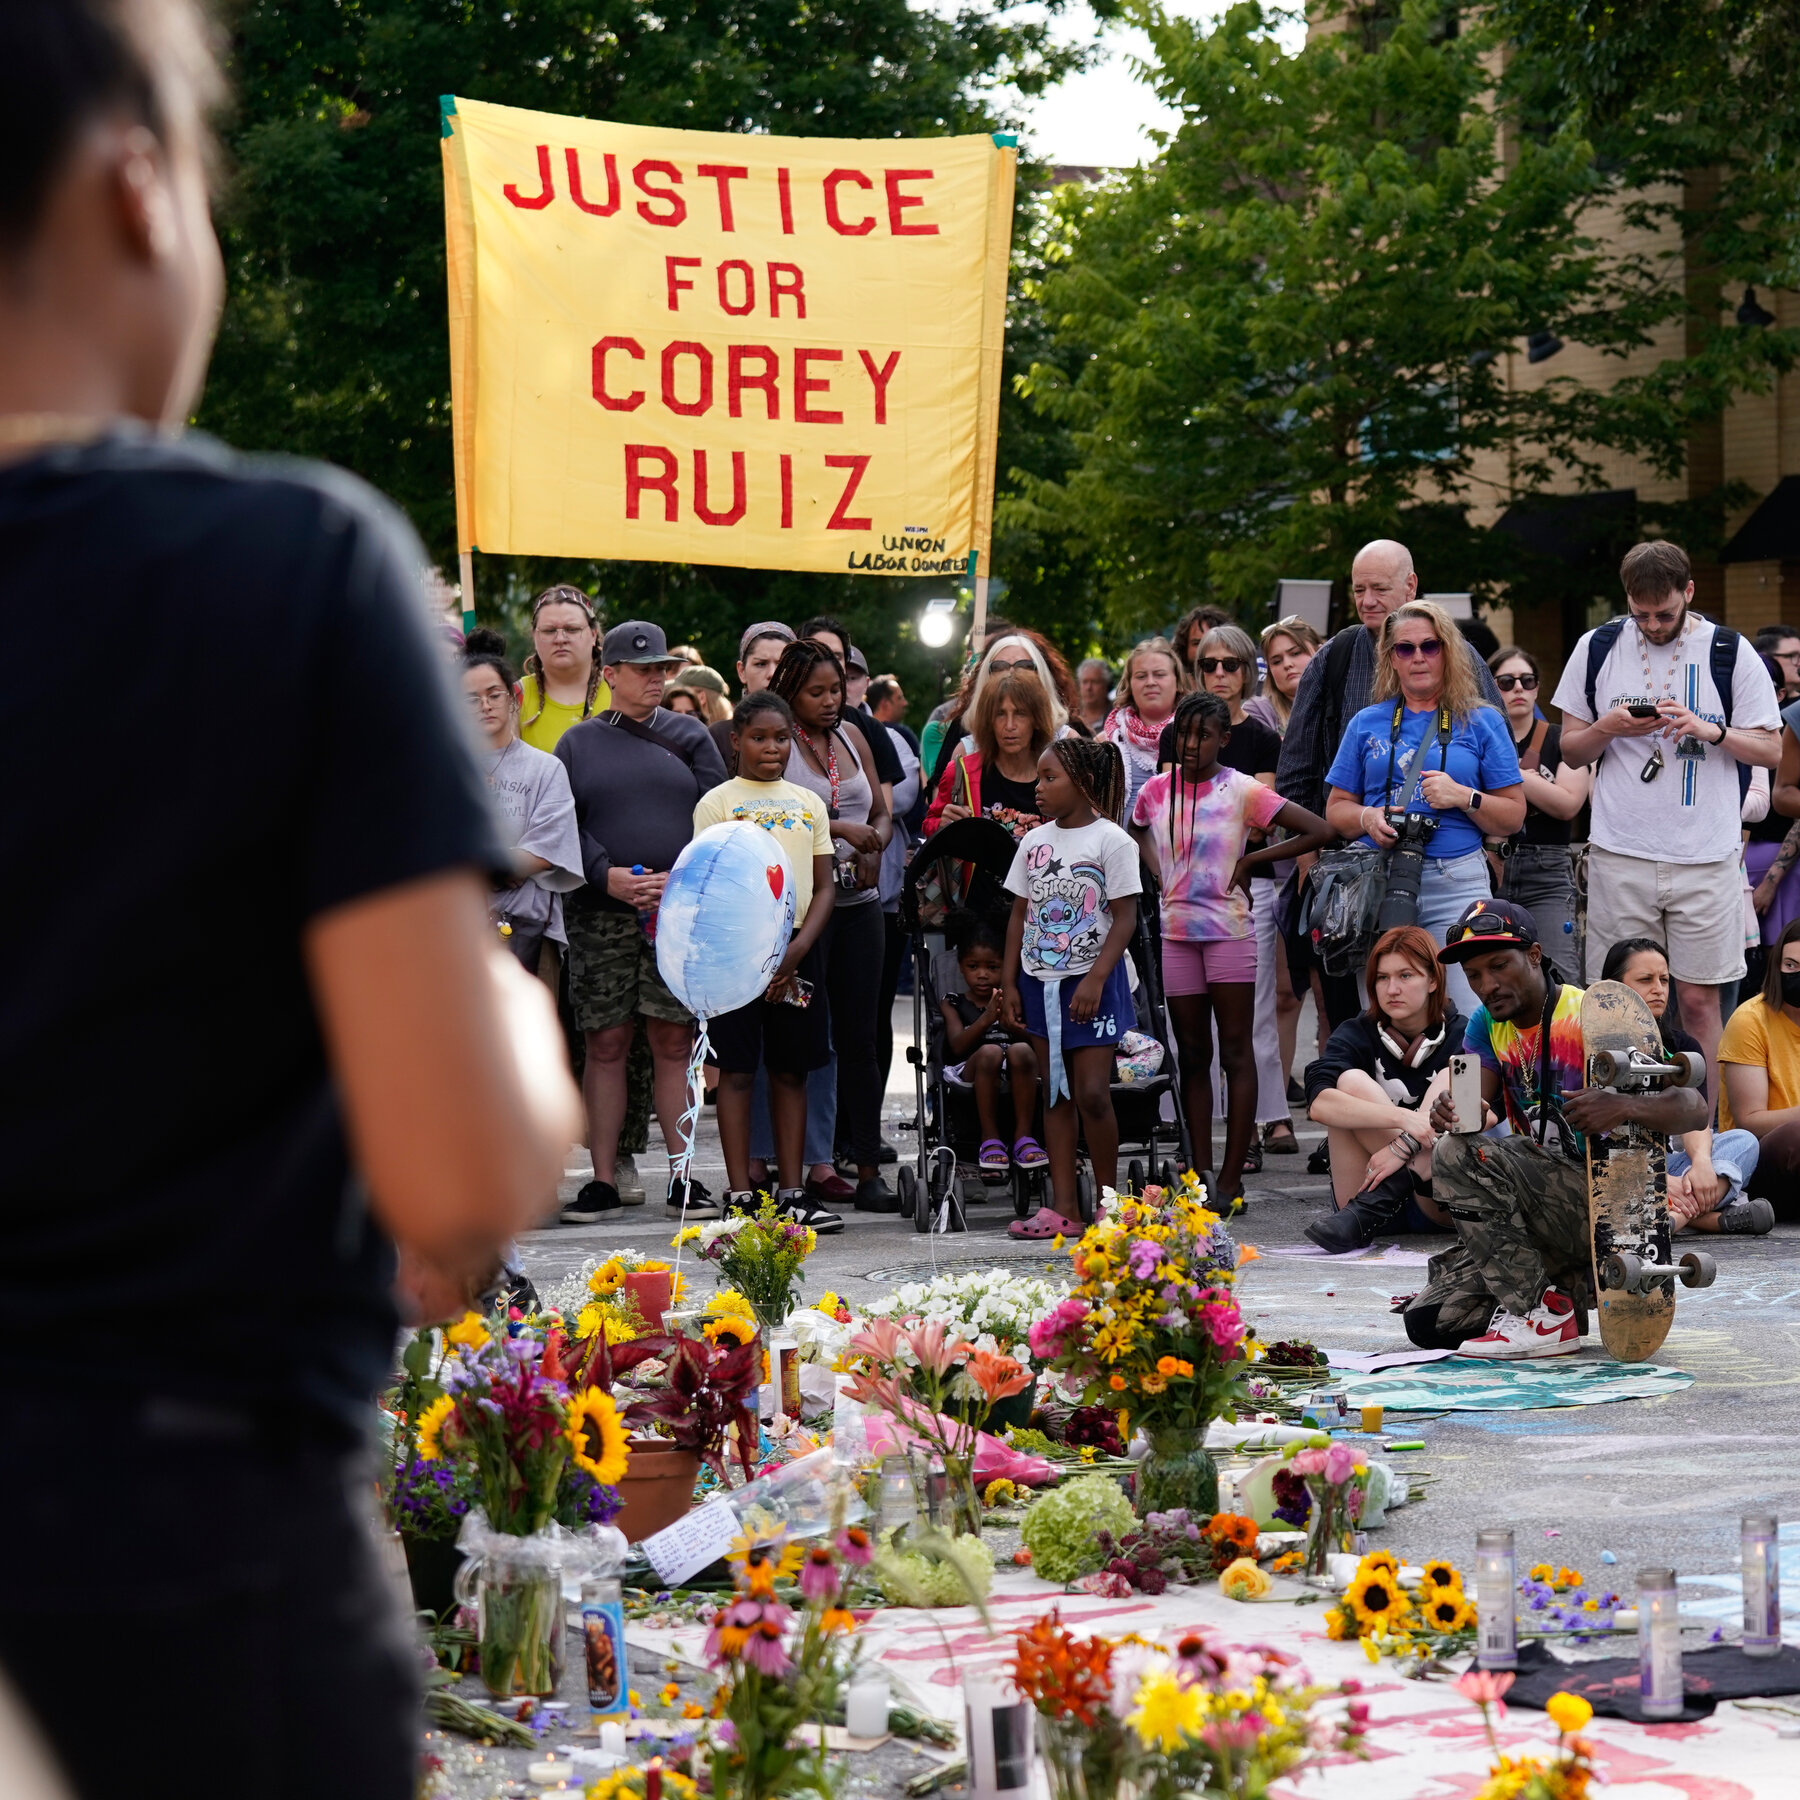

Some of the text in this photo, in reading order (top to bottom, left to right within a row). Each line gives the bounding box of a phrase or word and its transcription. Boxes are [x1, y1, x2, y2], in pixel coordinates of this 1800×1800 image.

[504, 145, 939, 235] JUSTICE
[665, 256, 806, 318] FOR
[592, 336, 900, 425] COREY
[625, 444, 872, 530] RUIZ
[848, 551, 907, 571] LABOR
[882, 535, 945, 553] UNION
[1441, 710, 1449, 729] Nikon
[1093, 1018, 1117, 1038] 76
